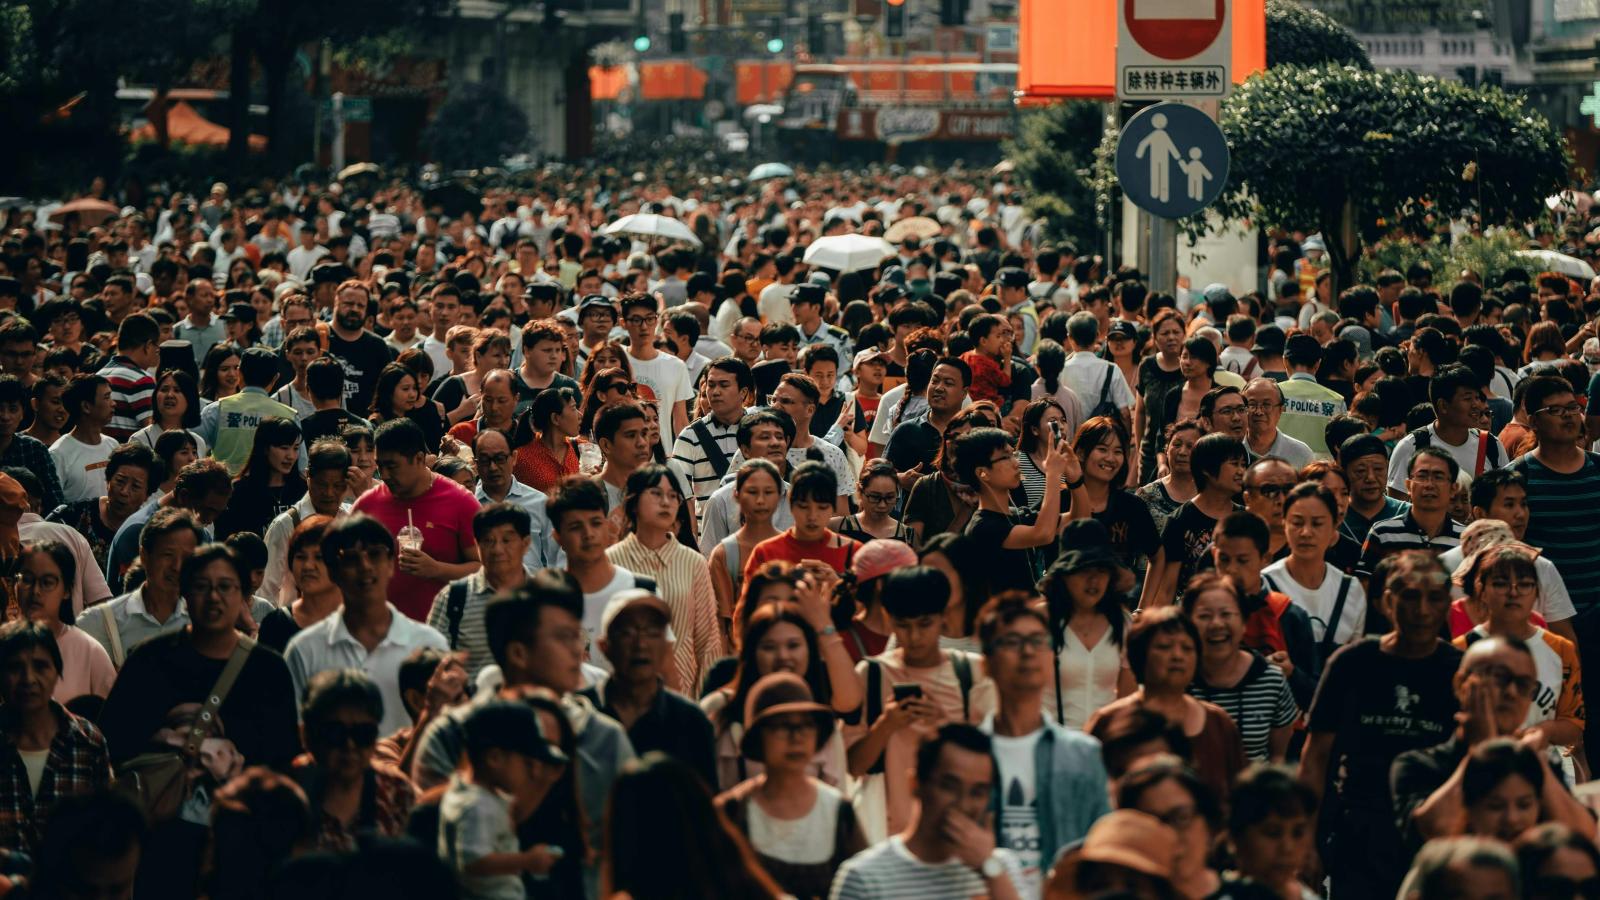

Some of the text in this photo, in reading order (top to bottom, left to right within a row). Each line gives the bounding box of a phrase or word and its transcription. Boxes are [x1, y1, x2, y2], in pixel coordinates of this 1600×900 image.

[1128, 70, 1220, 90] 除特种车辆外
[1290, 400, 1320, 413] POLICE
[1321, 402, 1335, 416] 察
[227, 412, 242, 428] 警
